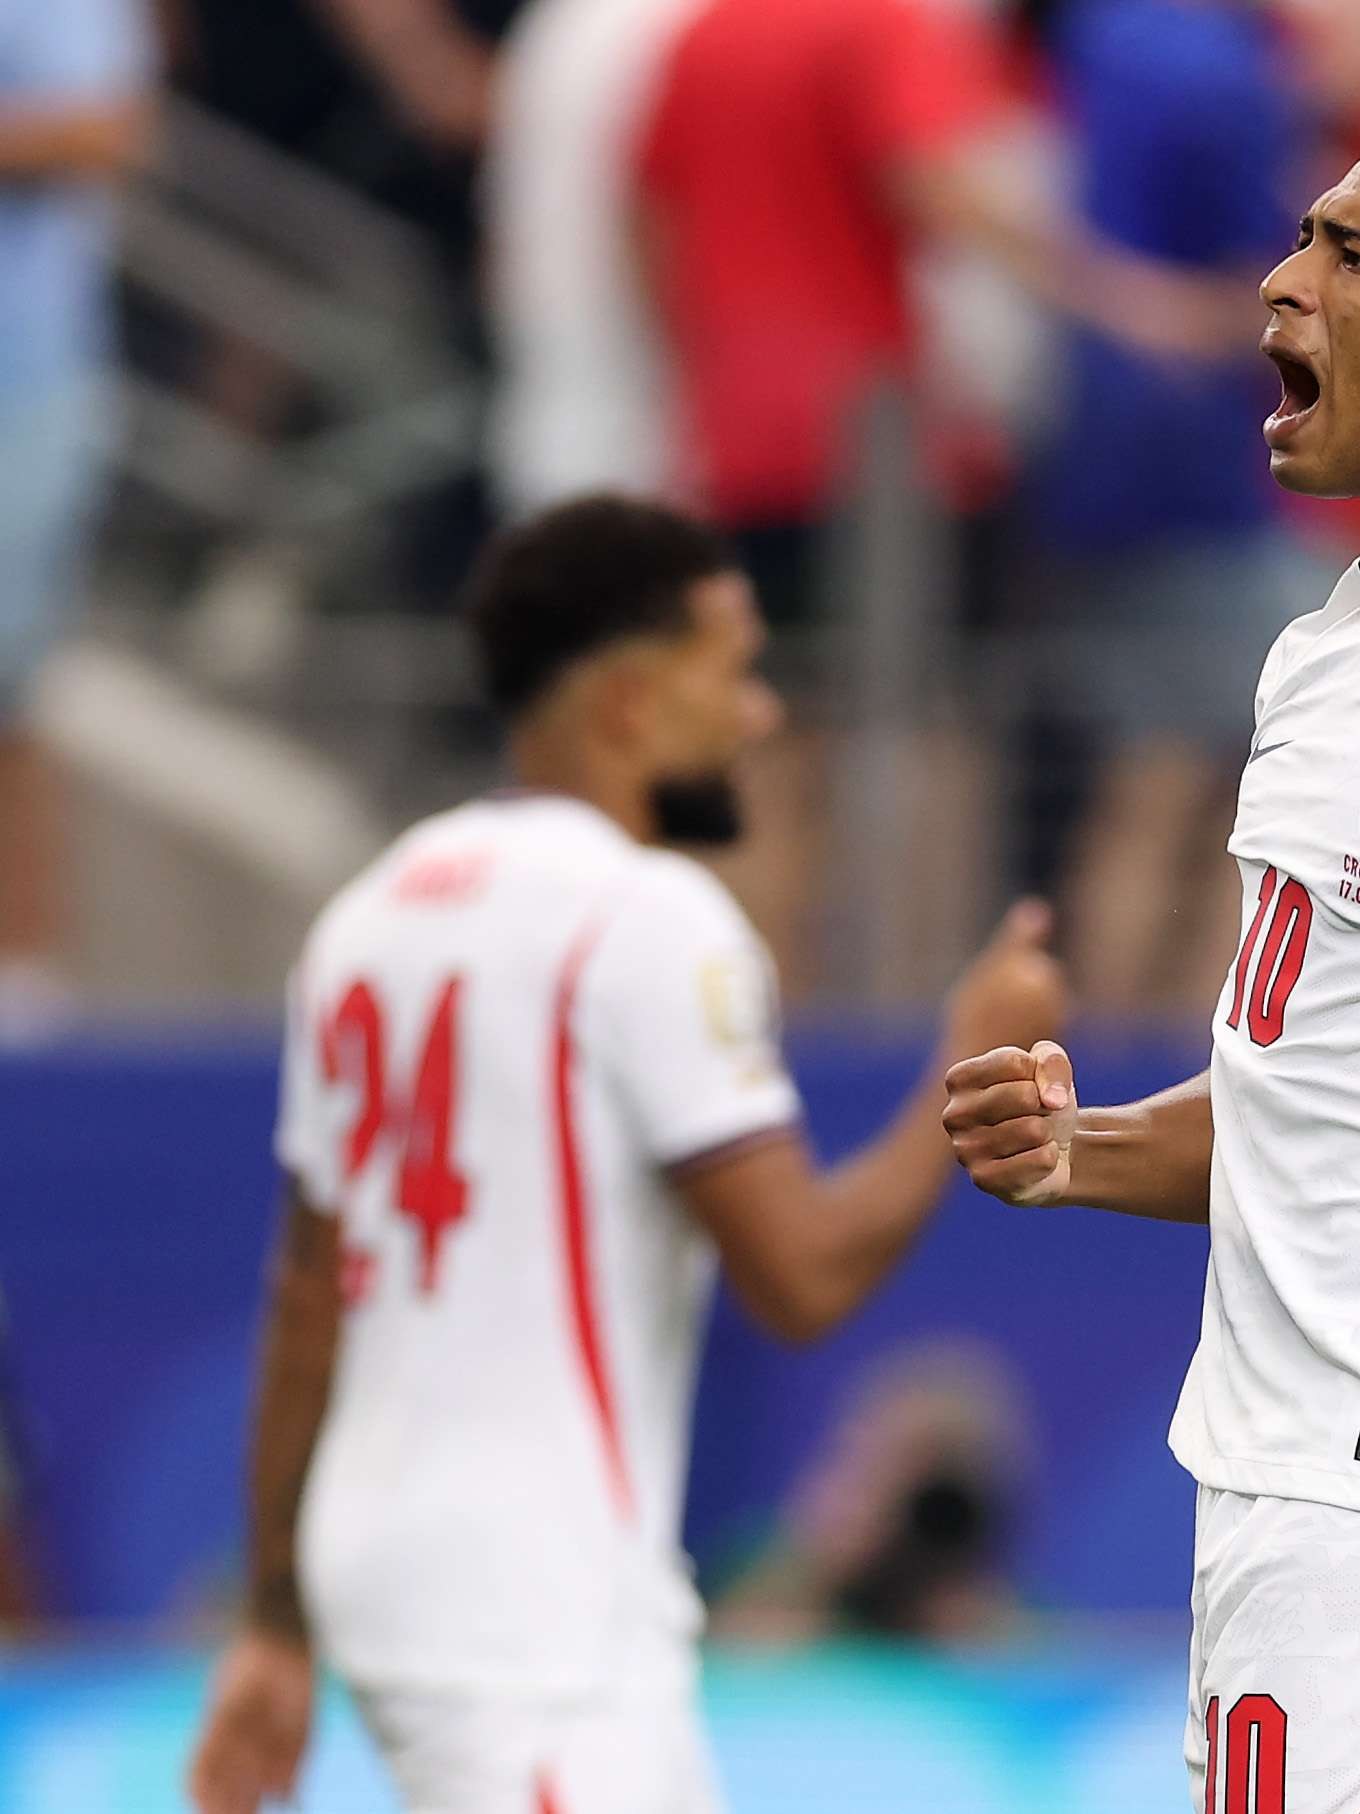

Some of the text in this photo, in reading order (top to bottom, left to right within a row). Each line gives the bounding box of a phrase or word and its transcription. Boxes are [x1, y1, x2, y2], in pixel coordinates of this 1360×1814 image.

[1225, 864, 1314, 1048] 10
[315, 965, 475, 1310] 24
[1204, 1693, 1288, 1814] 10
